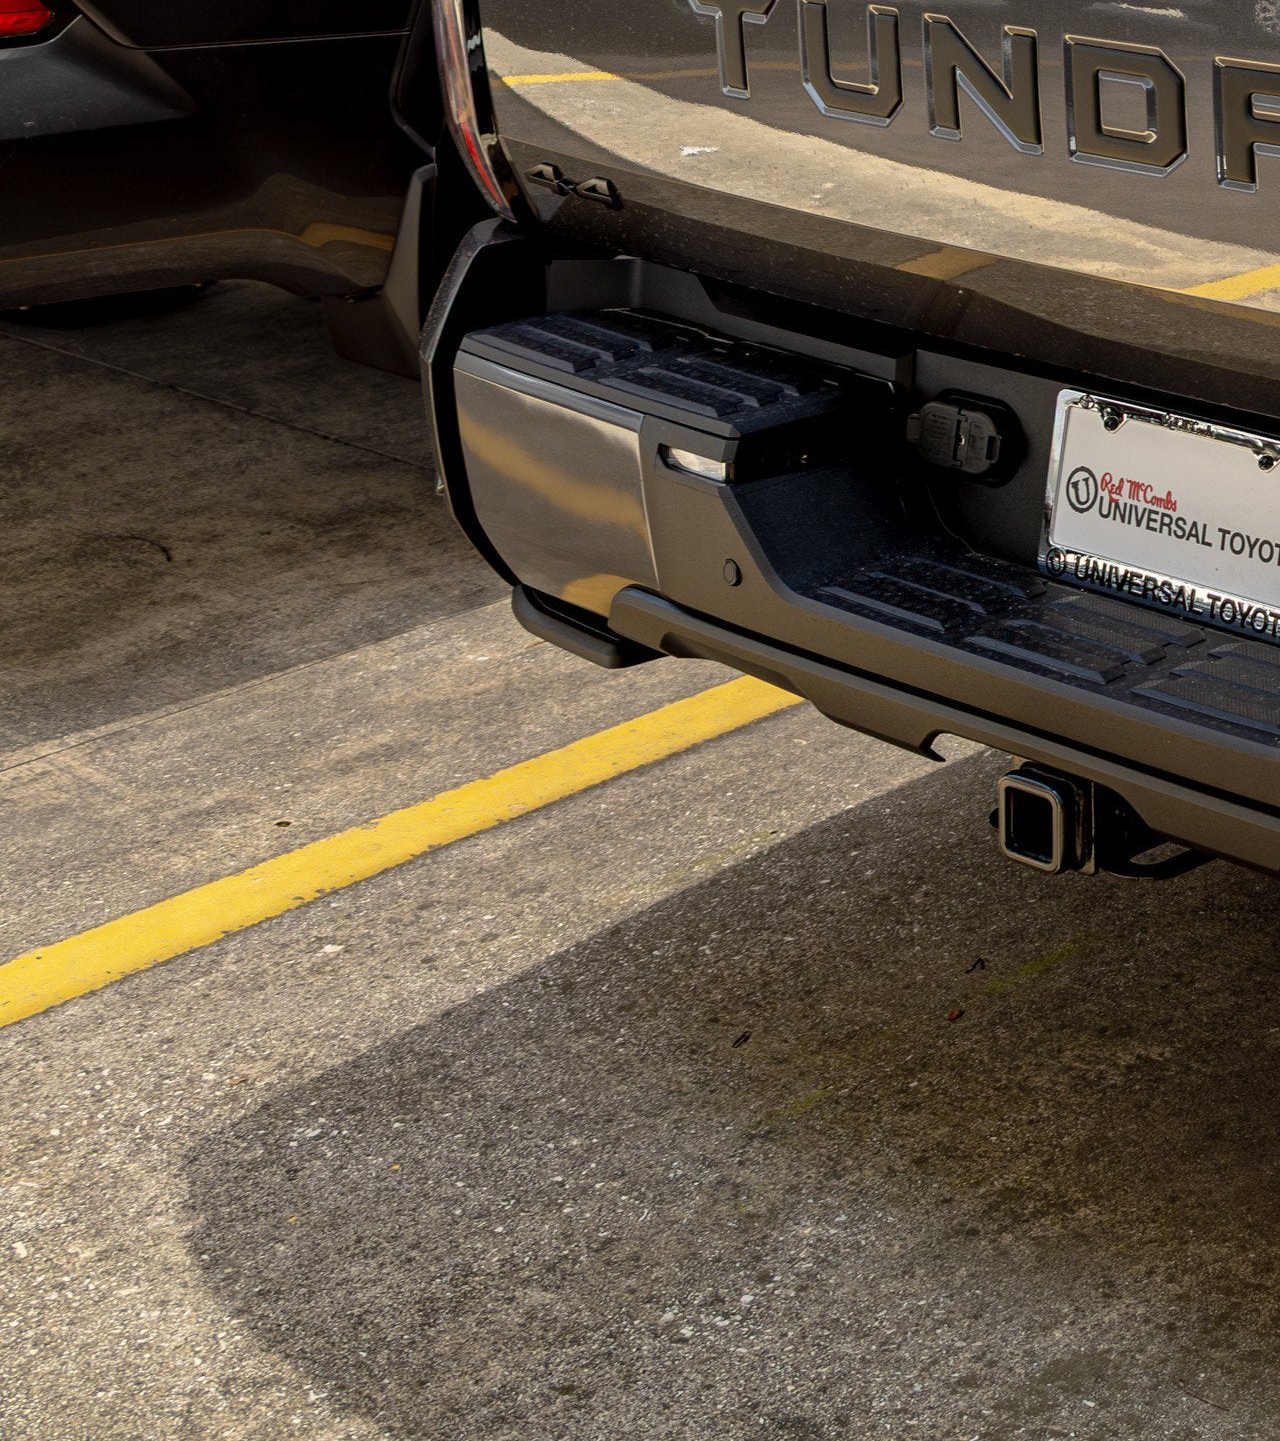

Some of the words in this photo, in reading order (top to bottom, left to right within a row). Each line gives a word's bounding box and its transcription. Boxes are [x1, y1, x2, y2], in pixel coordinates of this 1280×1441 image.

[1101, 472, 1124, 503] Red
[1098, 498, 1213, 547] UNIVERSAL
[1074, 555, 1203, 615] UNIVERSAL
